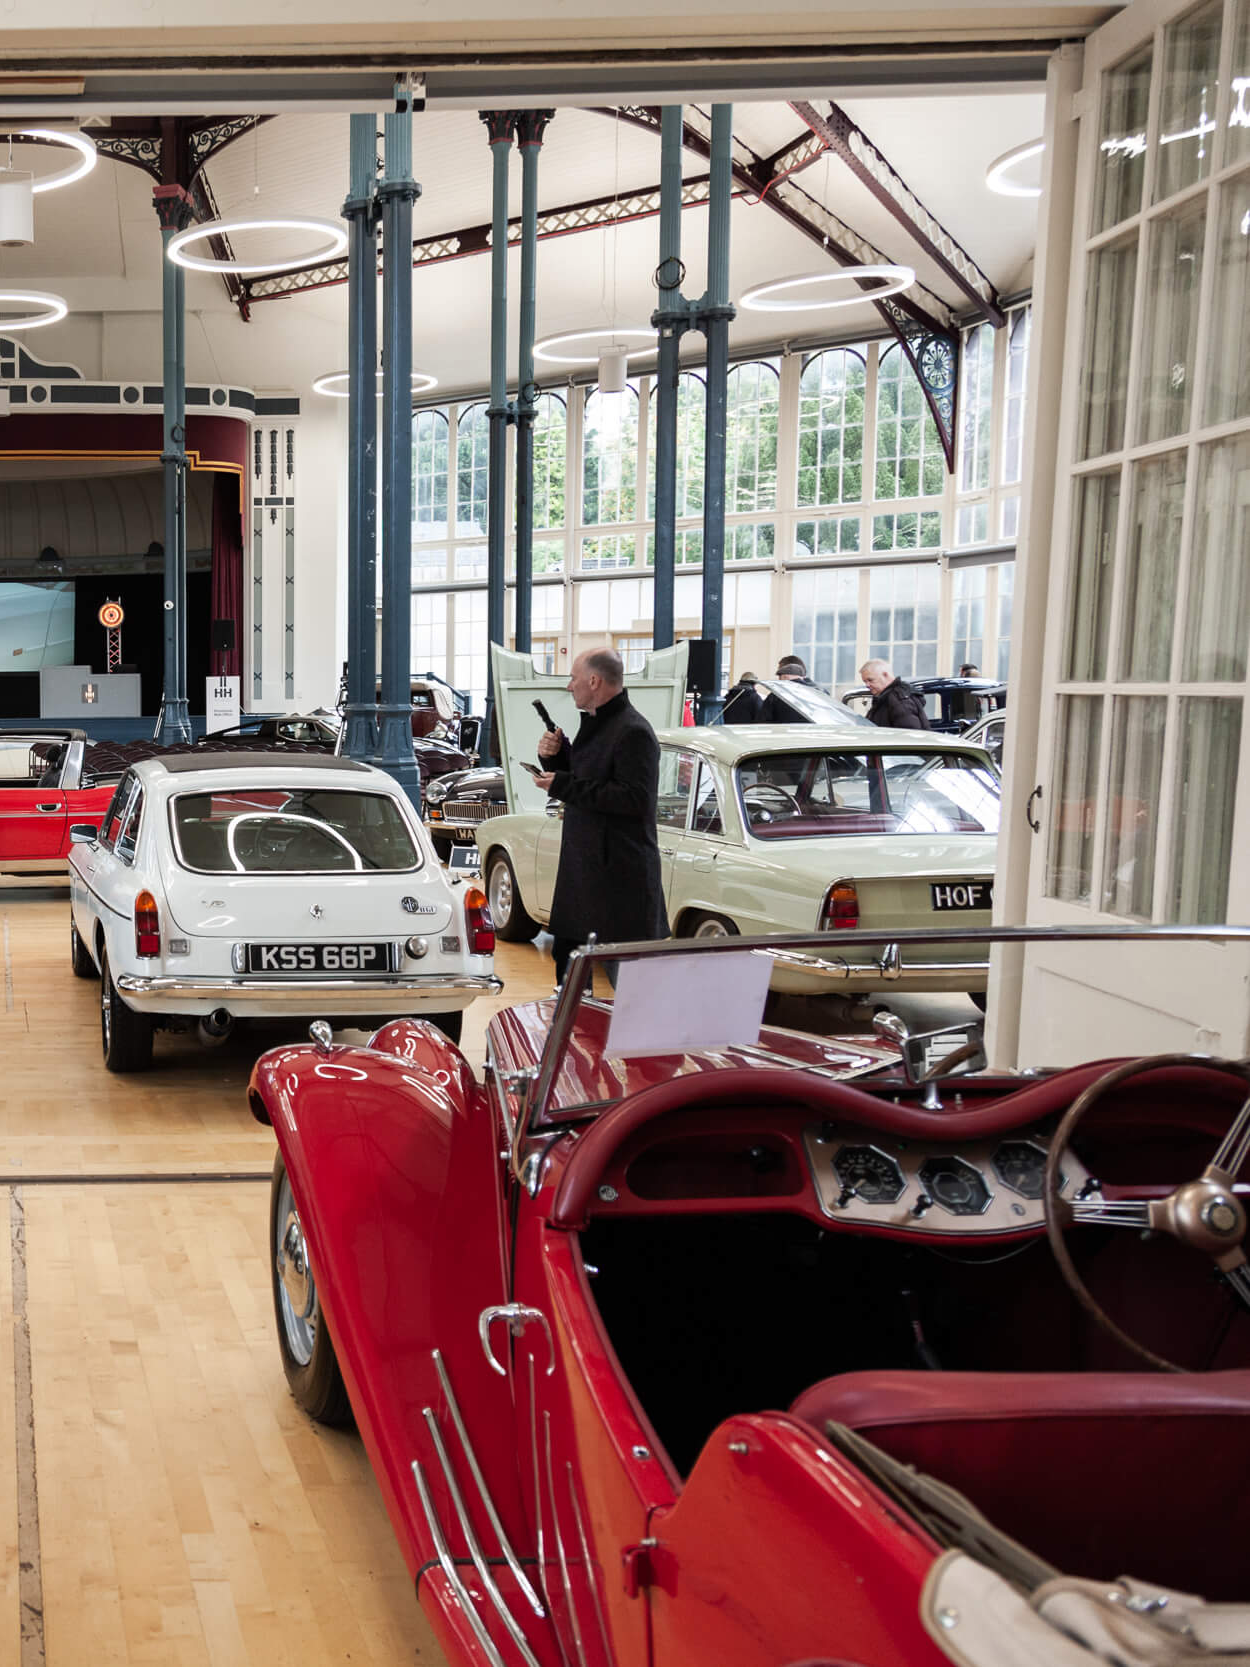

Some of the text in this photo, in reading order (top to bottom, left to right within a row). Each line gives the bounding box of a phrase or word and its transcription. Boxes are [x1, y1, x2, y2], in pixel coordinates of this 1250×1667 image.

[214, 688, 232, 698] HH
[458, 829, 475, 840] WA
[934, 885, 983, 907] HOF
[260, 946, 376, 969] KSS 66P
